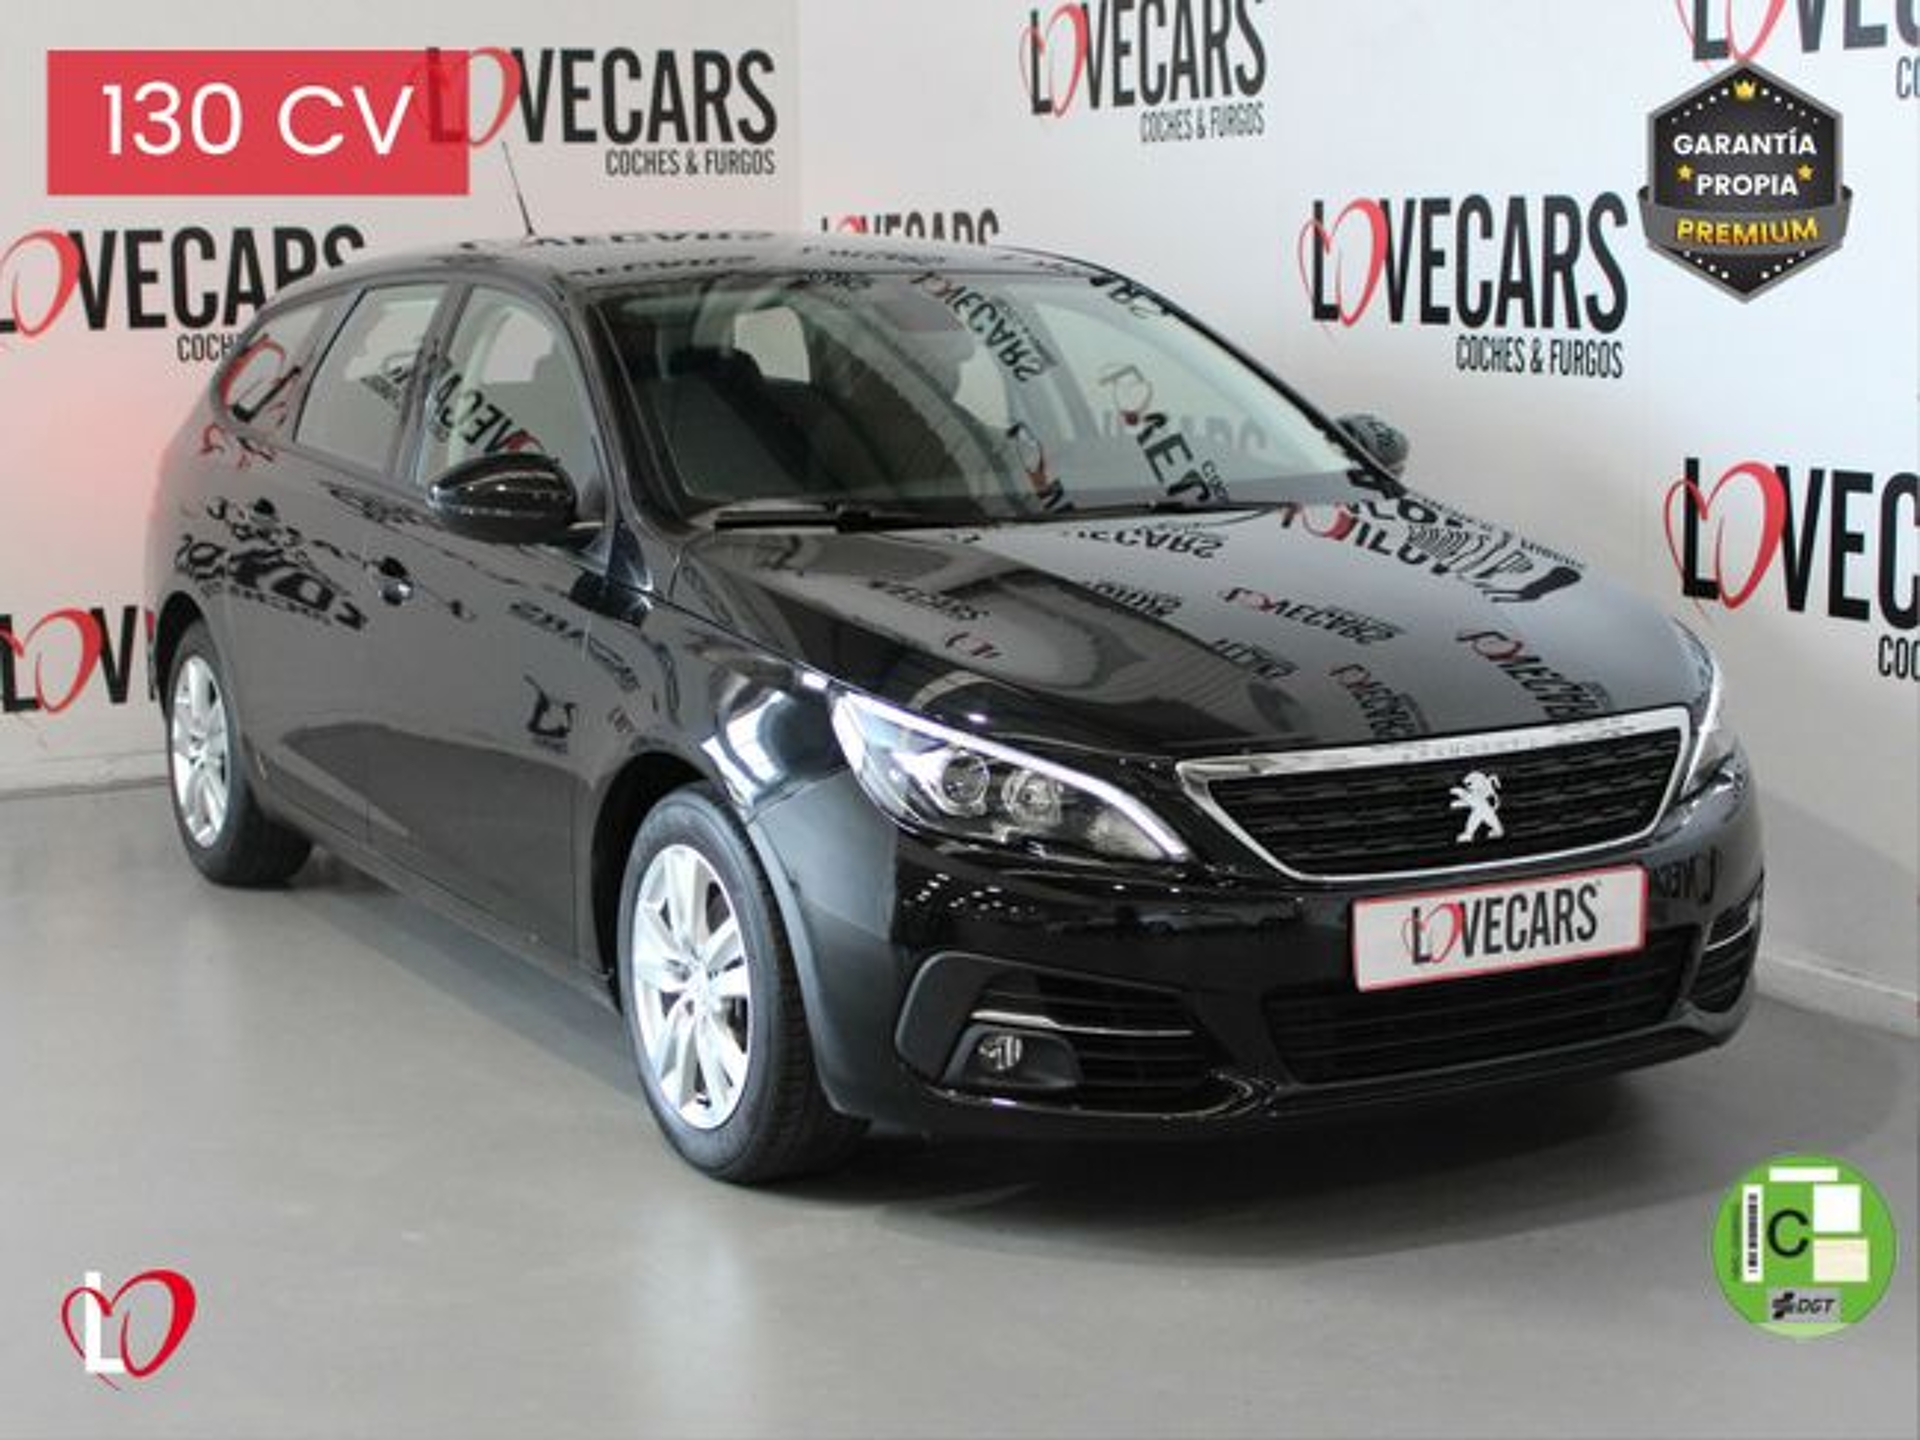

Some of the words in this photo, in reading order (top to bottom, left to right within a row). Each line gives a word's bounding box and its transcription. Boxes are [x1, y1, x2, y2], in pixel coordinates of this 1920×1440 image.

[1019, 0, 1267, 117] LOVECARS
[1140, 108, 1193, 143] COCHES
[1211, 102, 1265, 136] FURGOS
[605, 149, 680, 176] COCHES
[686, 150, 698, 176] &
[705, 149, 776, 176] FURGOS
[1297, 191, 1629, 334] LOVECARS
[1456, 334, 1525, 373] COCHES
[1530, 339, 1544, 374] &
[1550, 341, 1624, 380] FURGOS
[1402, 882, 1598, 965] LOVECARS
